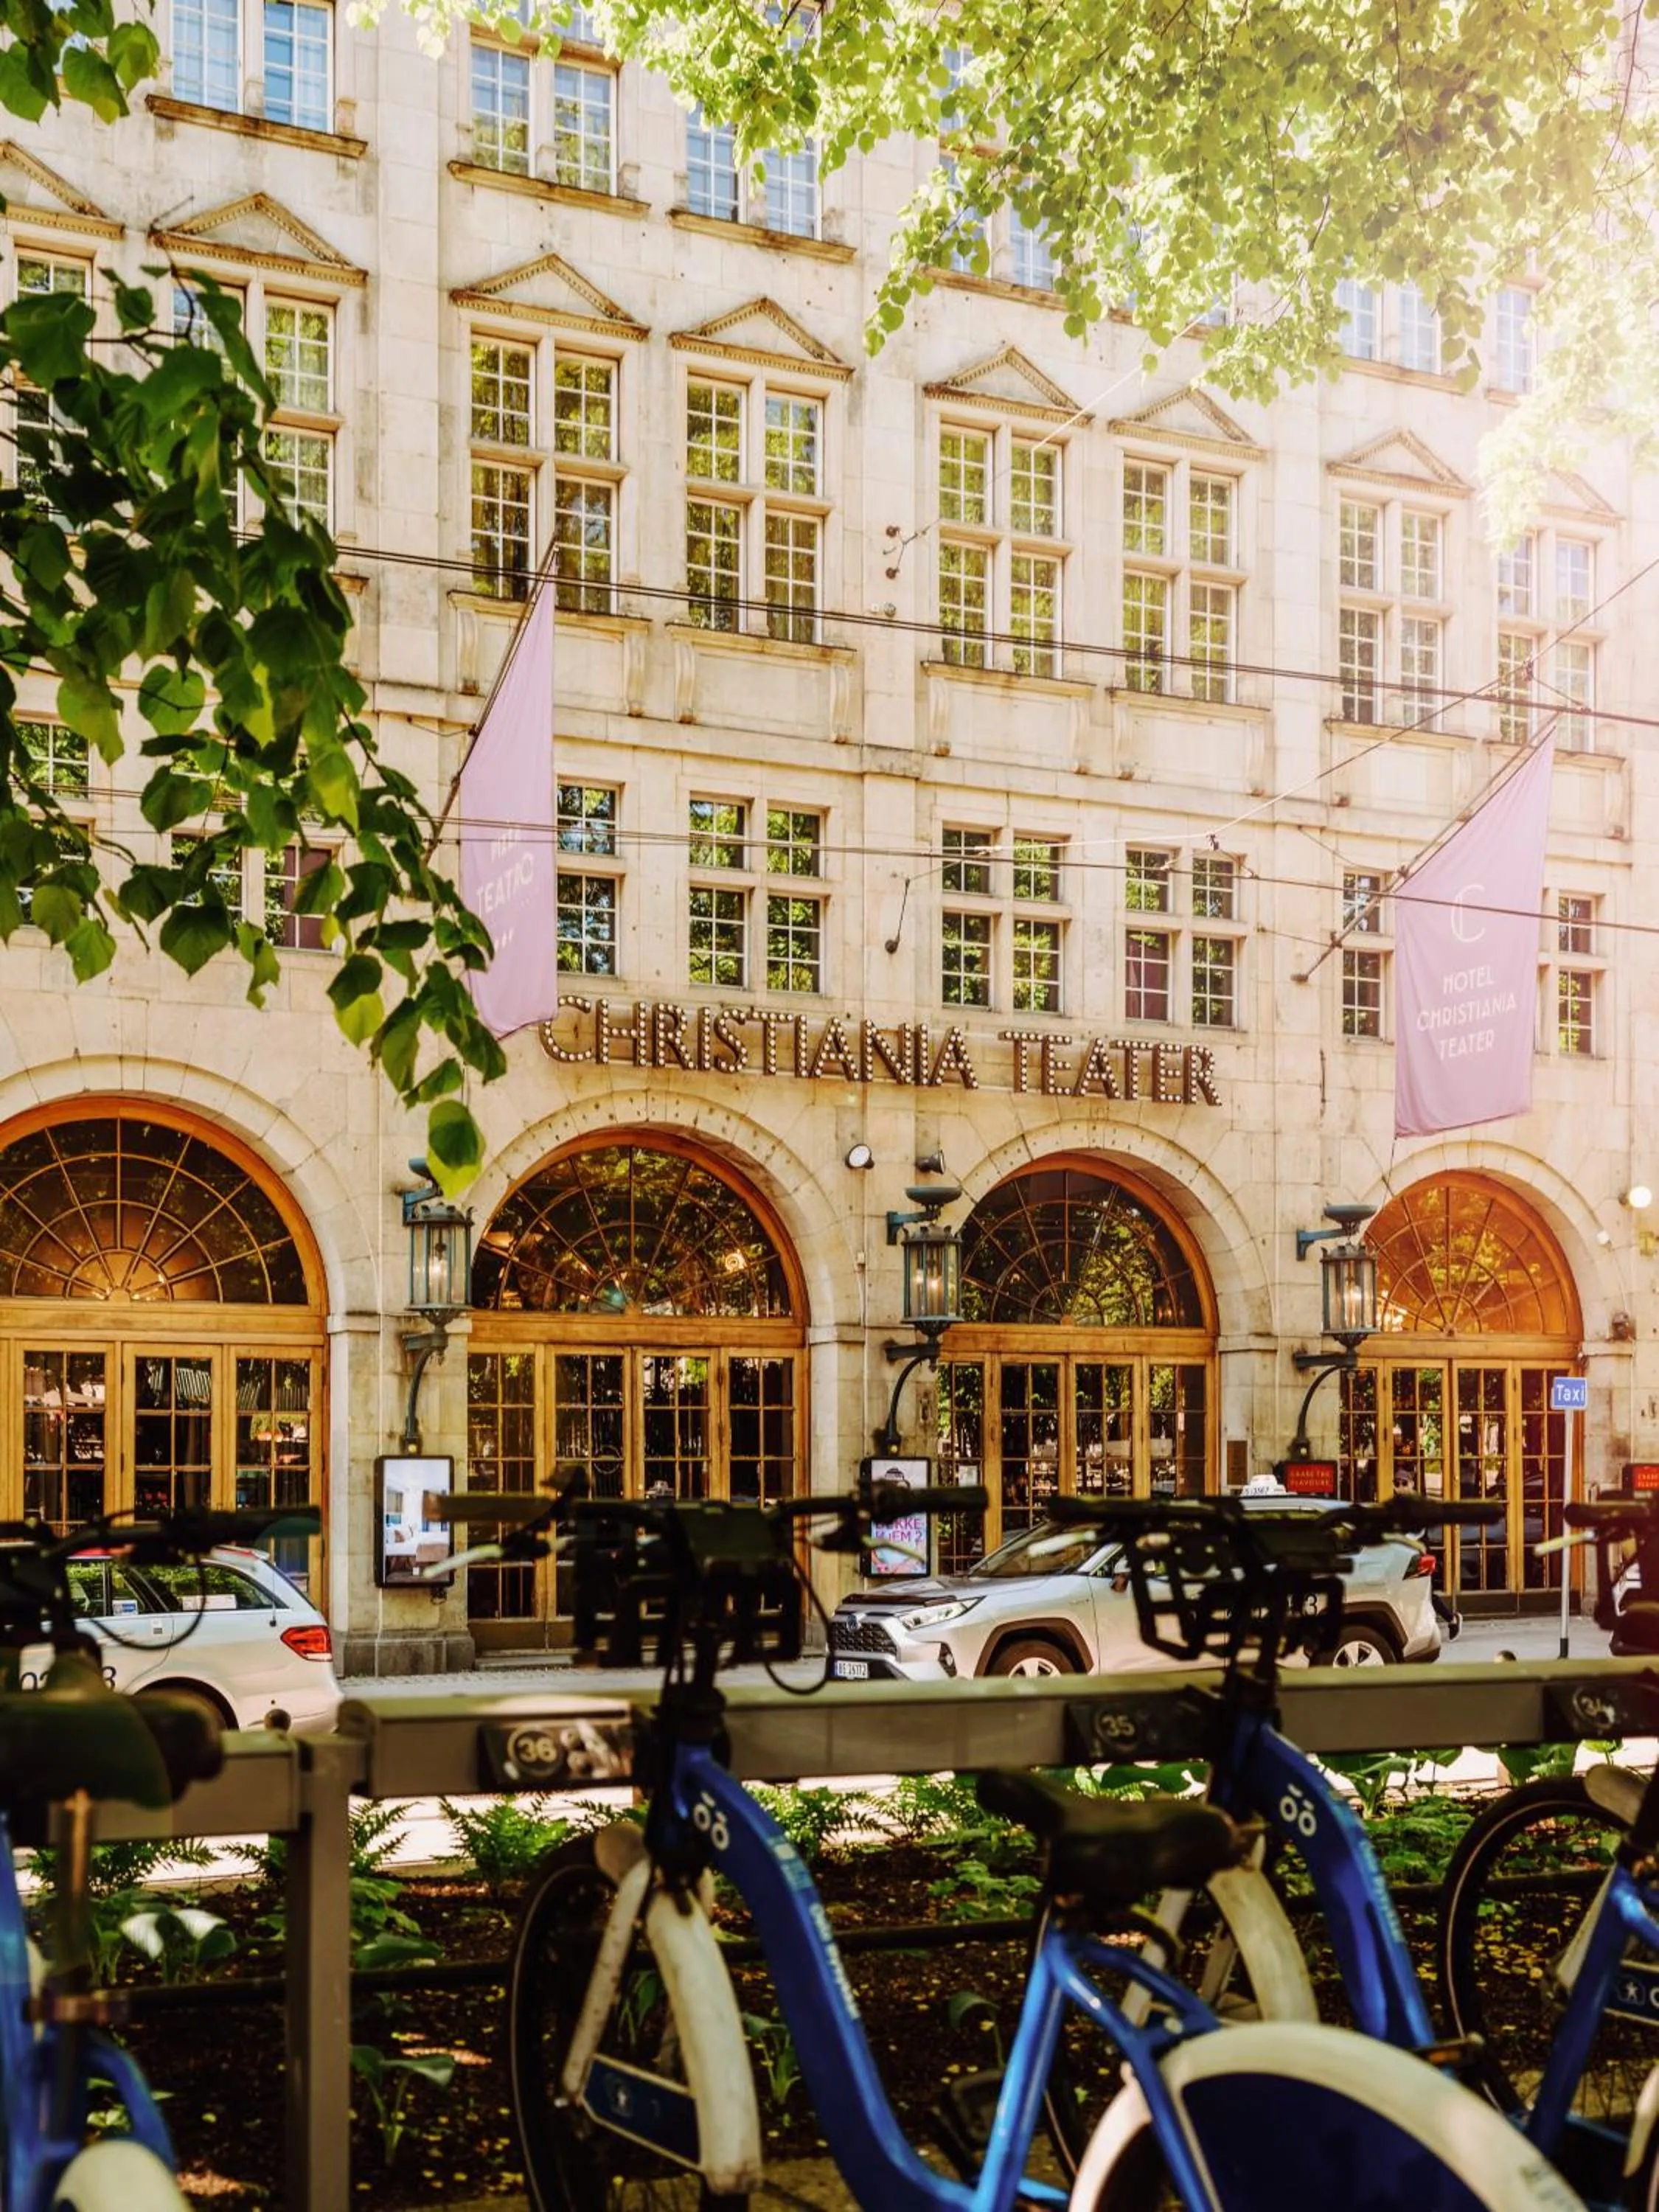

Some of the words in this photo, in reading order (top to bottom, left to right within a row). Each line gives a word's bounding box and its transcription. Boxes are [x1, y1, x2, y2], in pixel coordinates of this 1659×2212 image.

[1450, 883, 1486, 943] C
[1443, 964, 1495, 994] HOTEL
[1417, 992, 1517, 1032] CHRISTIANIA
[540, 995, 979, 1090] CHRISTIANIA
[998, 1030, 1222, 1106] TEATER
[1439, 1029, 1495, 1060] TEATER
[1557, 1384, 1585, 1402] Taxi
[1102, 1714, 1135, 1736] 35
[518, 1737, 557, 1763] 36
